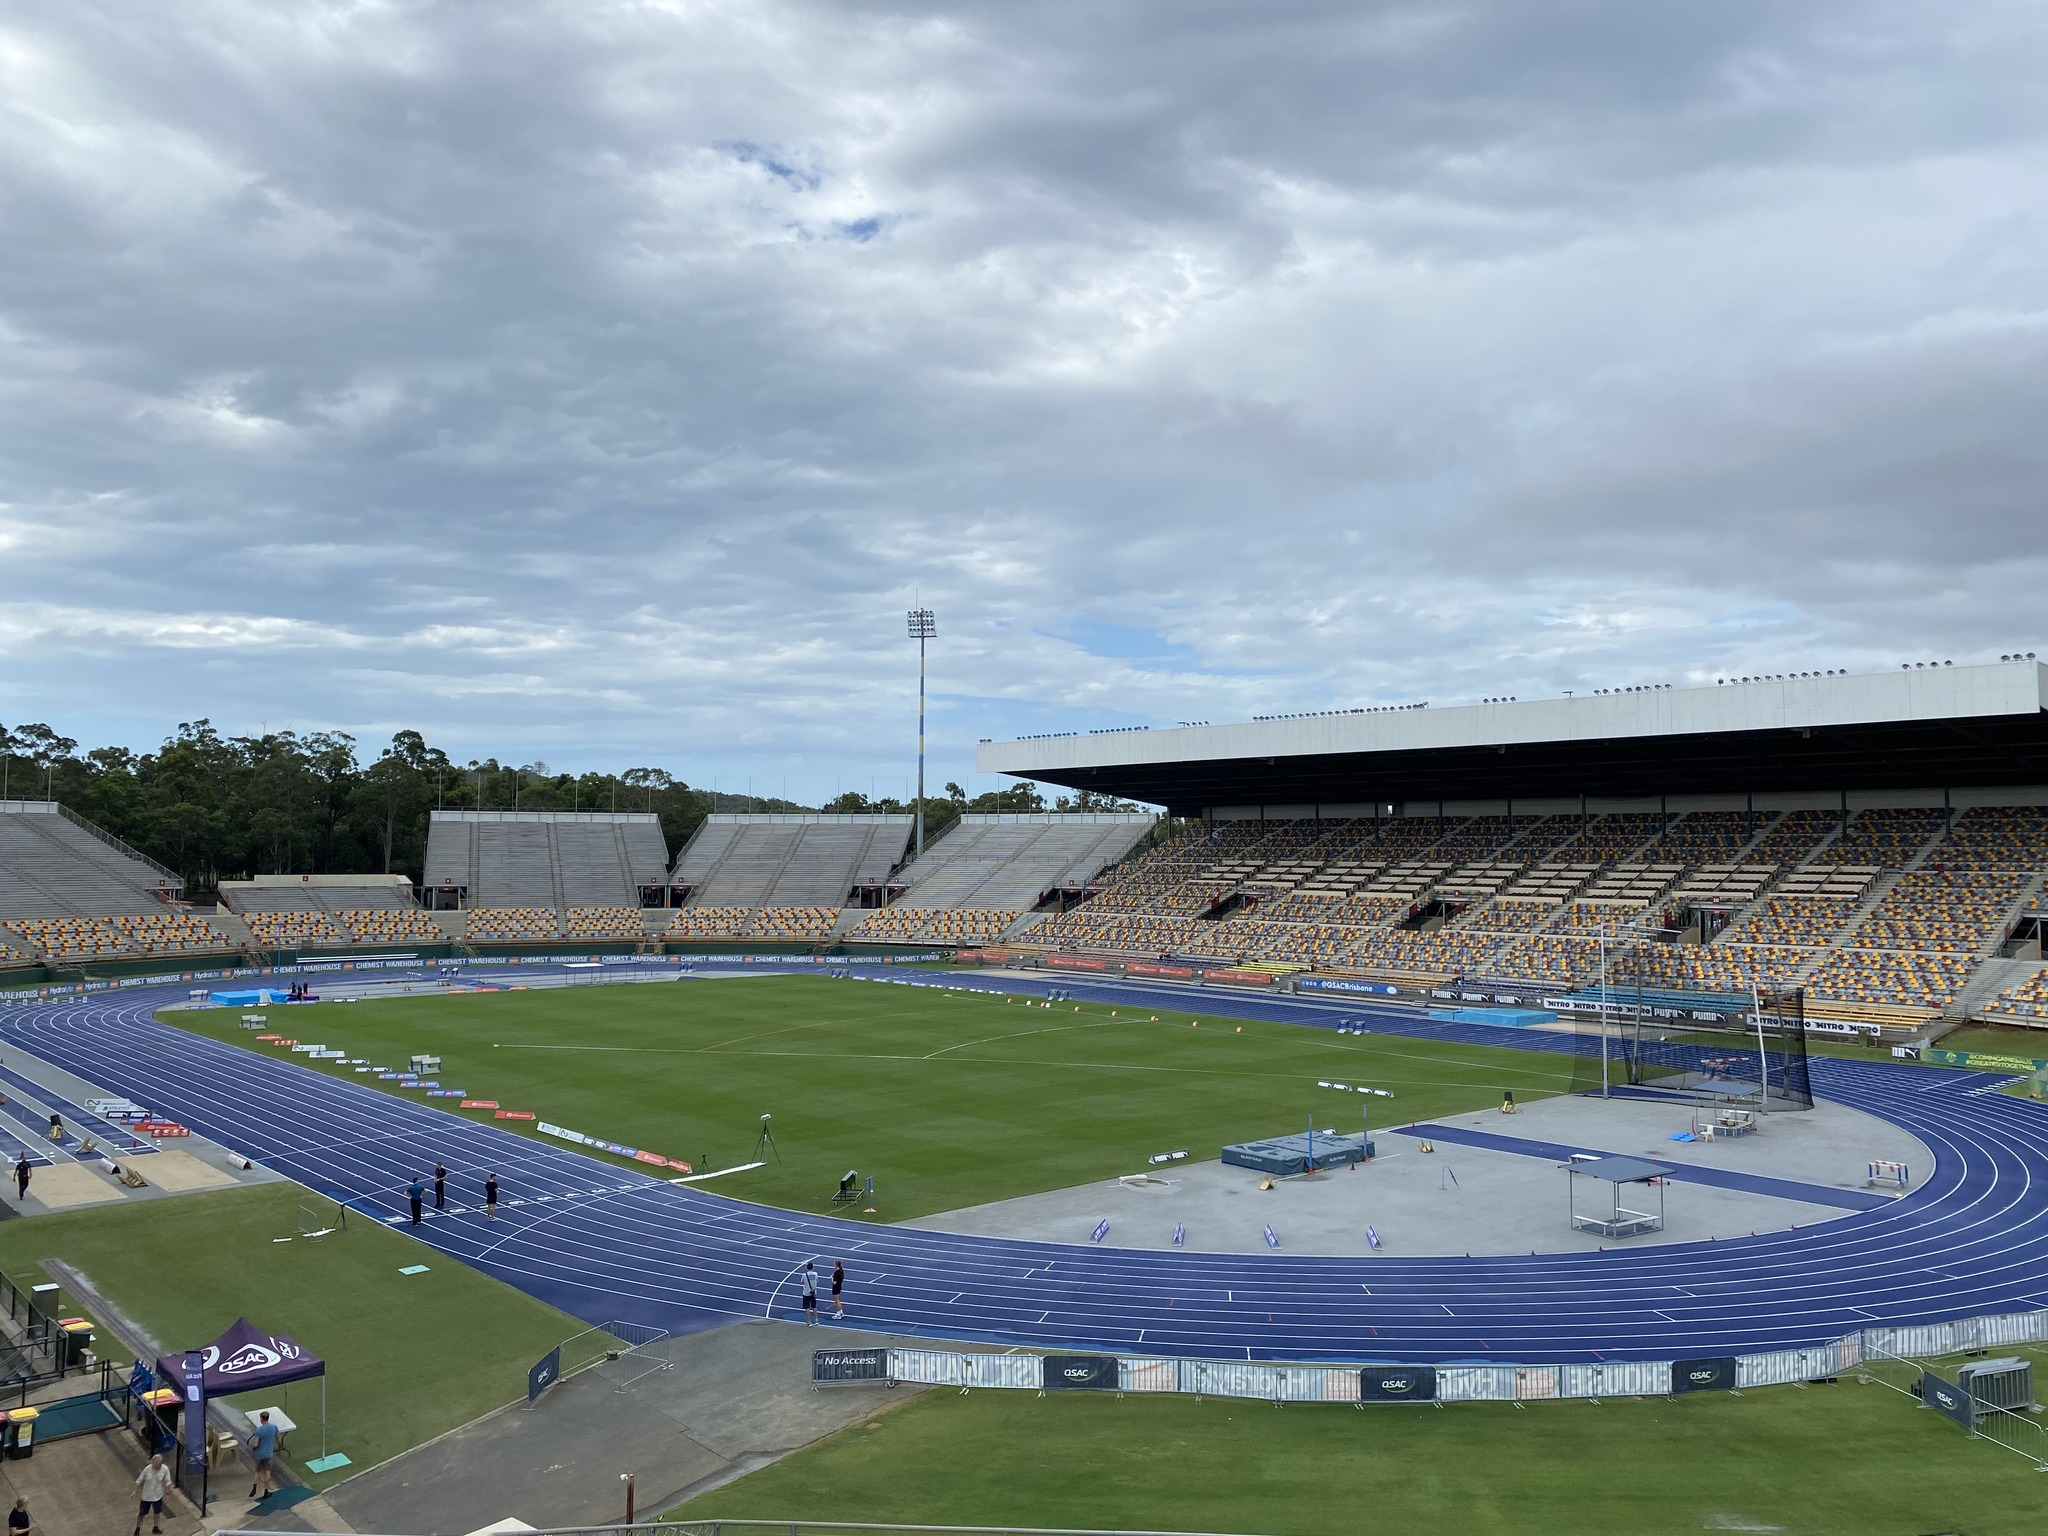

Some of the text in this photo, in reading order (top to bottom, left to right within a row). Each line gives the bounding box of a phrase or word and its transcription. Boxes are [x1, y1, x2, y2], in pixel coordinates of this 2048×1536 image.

[356, 959, 424, 970] CHEMIST WAREHOUSE
[438, 956, 507, 966] CHEMIST WAREHOUSE
[520, 956, 549, 964] CHEMIST
[273, 963, 342, 974] CHEMIST WAREHOUSE
[119, 974, 181, 988] CHEMIST WAREHOUSE
[1321, 980, 1373, 992] @QSACBrisbane
[1432, 990, 1451, 999] PUMA
[1462, 992, 1482, 1001] PUMA
[1548, 1000, 1570, 1008] NITRO
[1574, 1002, 1596, 1010] NITRO
[1693, 1010, 1718, 1021] PUMA
[1815, 1021, 1844, 1031] NITRO
[219, 1352, 265, 1372] QSAC
[824, 1356, 877, 1366] No Access
[1064, 1369, 1089, 1377] QSAC
[1689, 1370, 1712, 1380] QSAC
[1382, 1380, 1407, 1389] QSAC
